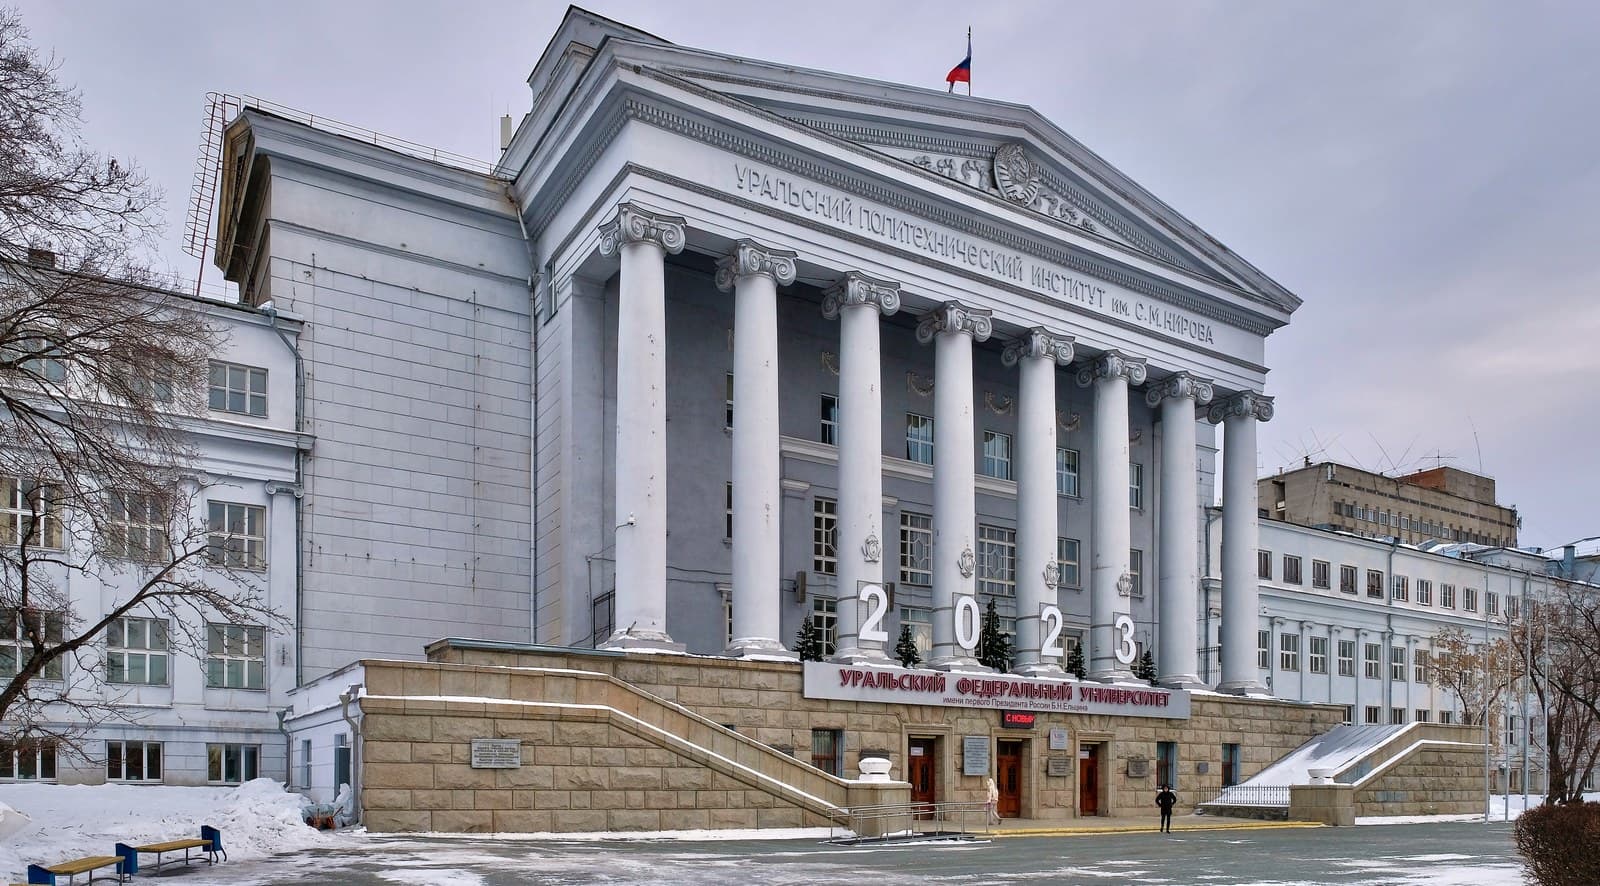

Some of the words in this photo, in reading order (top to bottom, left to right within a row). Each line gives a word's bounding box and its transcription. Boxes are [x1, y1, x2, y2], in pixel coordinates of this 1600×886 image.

[735, 163, 853, 226] УРАЛЬСКИЙ
[859, 206, 1024, 282] ПОЛИТЕХНИЧЕСКИЙ
[1031, 265, 1106, 308] ИНСТИТУТ
[840, 669, 946, 693] УРАЛЬСКИЙ
[957, 677, 1073, 701] ФЕДЕРАЛЬНЫЙ
[1080, 686, 1171, 708] УНИВЕРСИТЕТ
[965, 698, 991, 706] первого
[992, 699, 1028, 708] Президента
[1029, 701, 1051, 710] России
